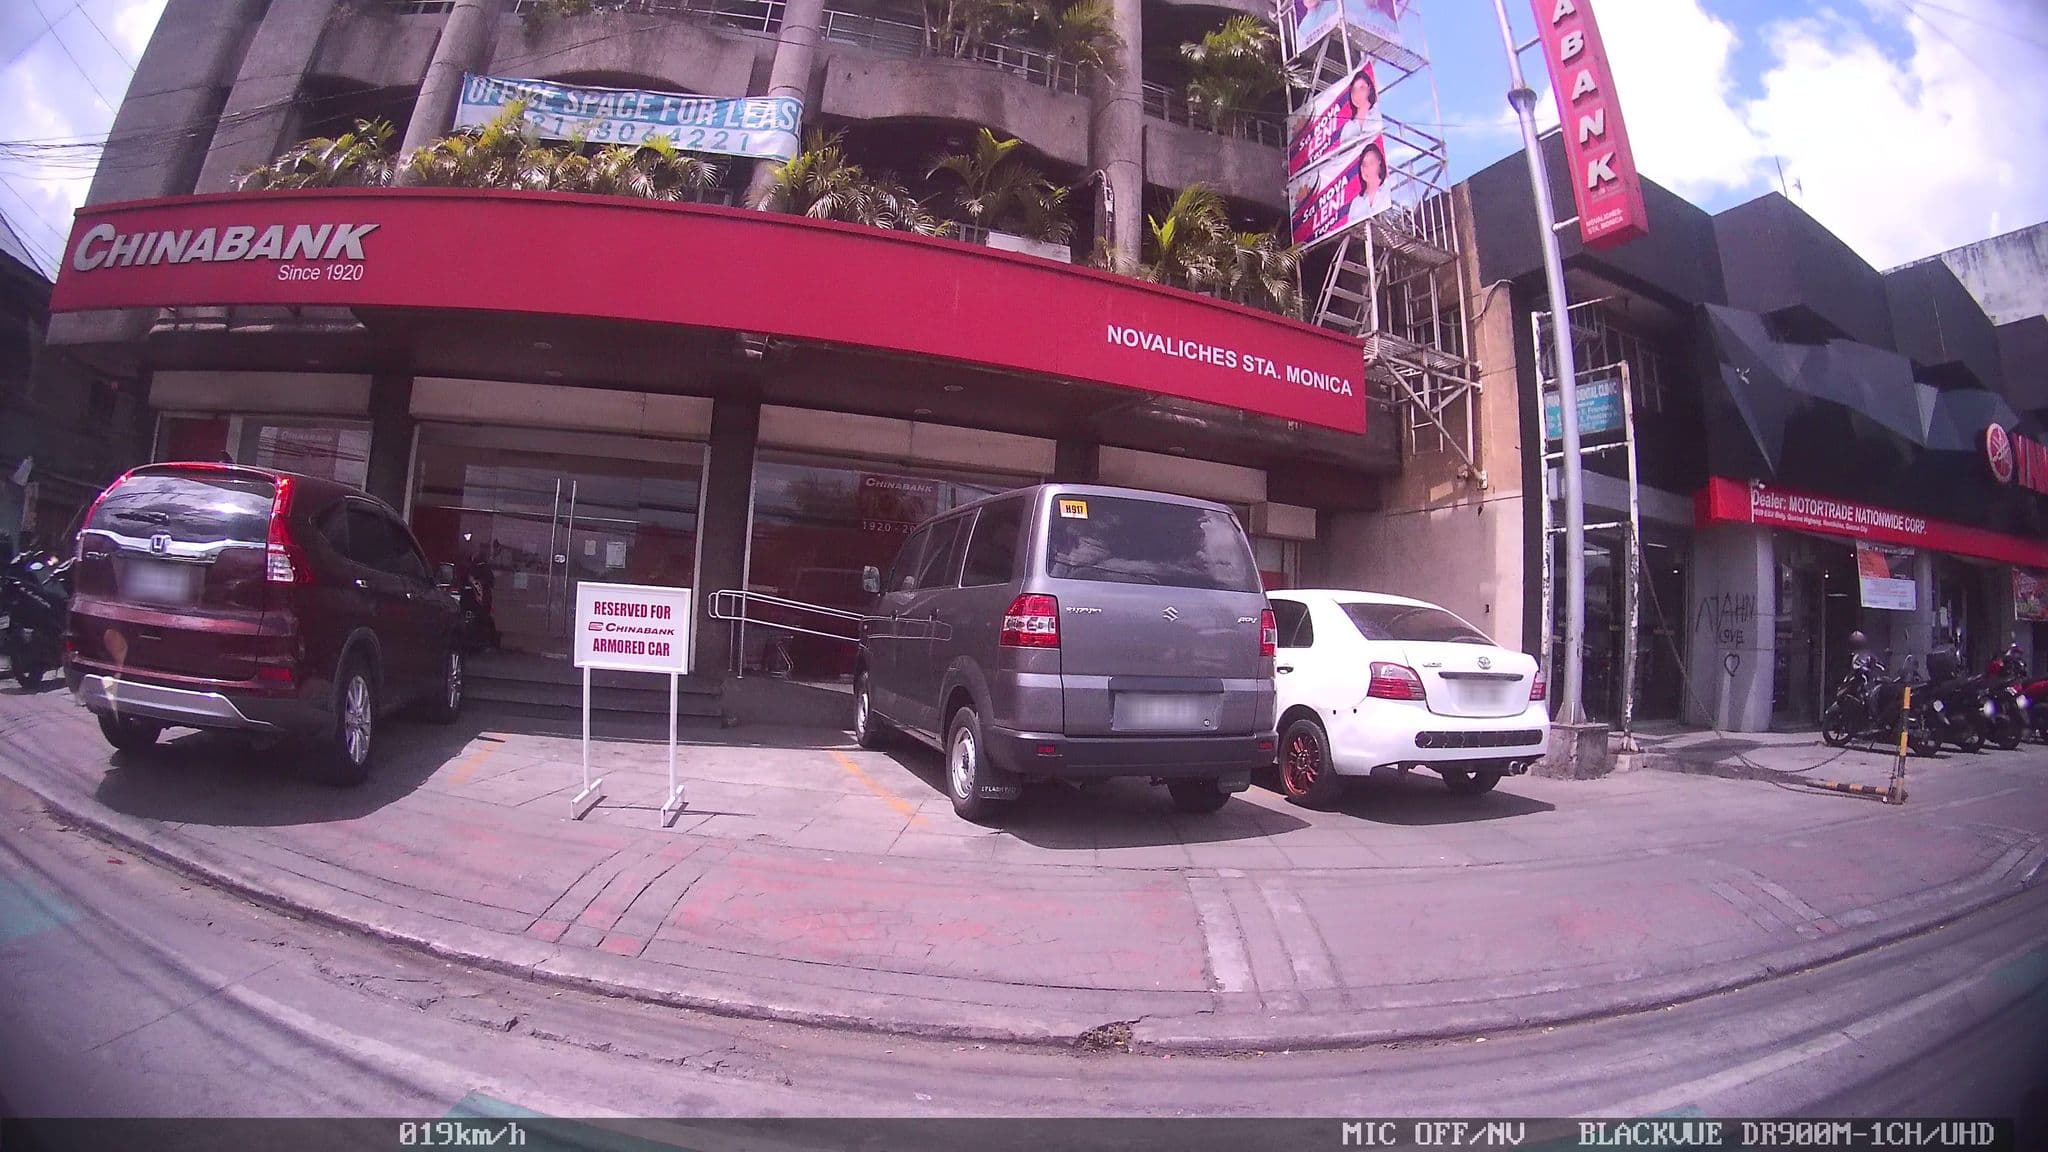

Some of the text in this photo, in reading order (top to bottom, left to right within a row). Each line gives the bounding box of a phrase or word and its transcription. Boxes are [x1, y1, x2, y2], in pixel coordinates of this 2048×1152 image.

[564, 89, 655, 120] SPACE
[660, 97, 717, 125] FOR
[723, 99, 802, 132] LEAS
[1314, 103, 1341, 135] NOVA
[1308, 118, 1337, 157] LENI
[1318, 175, 1349, 206] NOVA
[1312, 191, 1346, 232] LENI
[278, 264, 364, 281] Since 1920
[1107, 324, 1353, 396] NOVALICHES STA. MONICA
[1752, 489, 1787, 510] Dealer:
[1789, 496, 1853, 522] MOTORTRADE
[1855, 507, 1903, 532] NATIONWIDE
[863, 521, 891, 533] 1920
[594, 601, 671, 619] RESERVED FOR
[593, 638, 670, 656] ARMORED CAR
